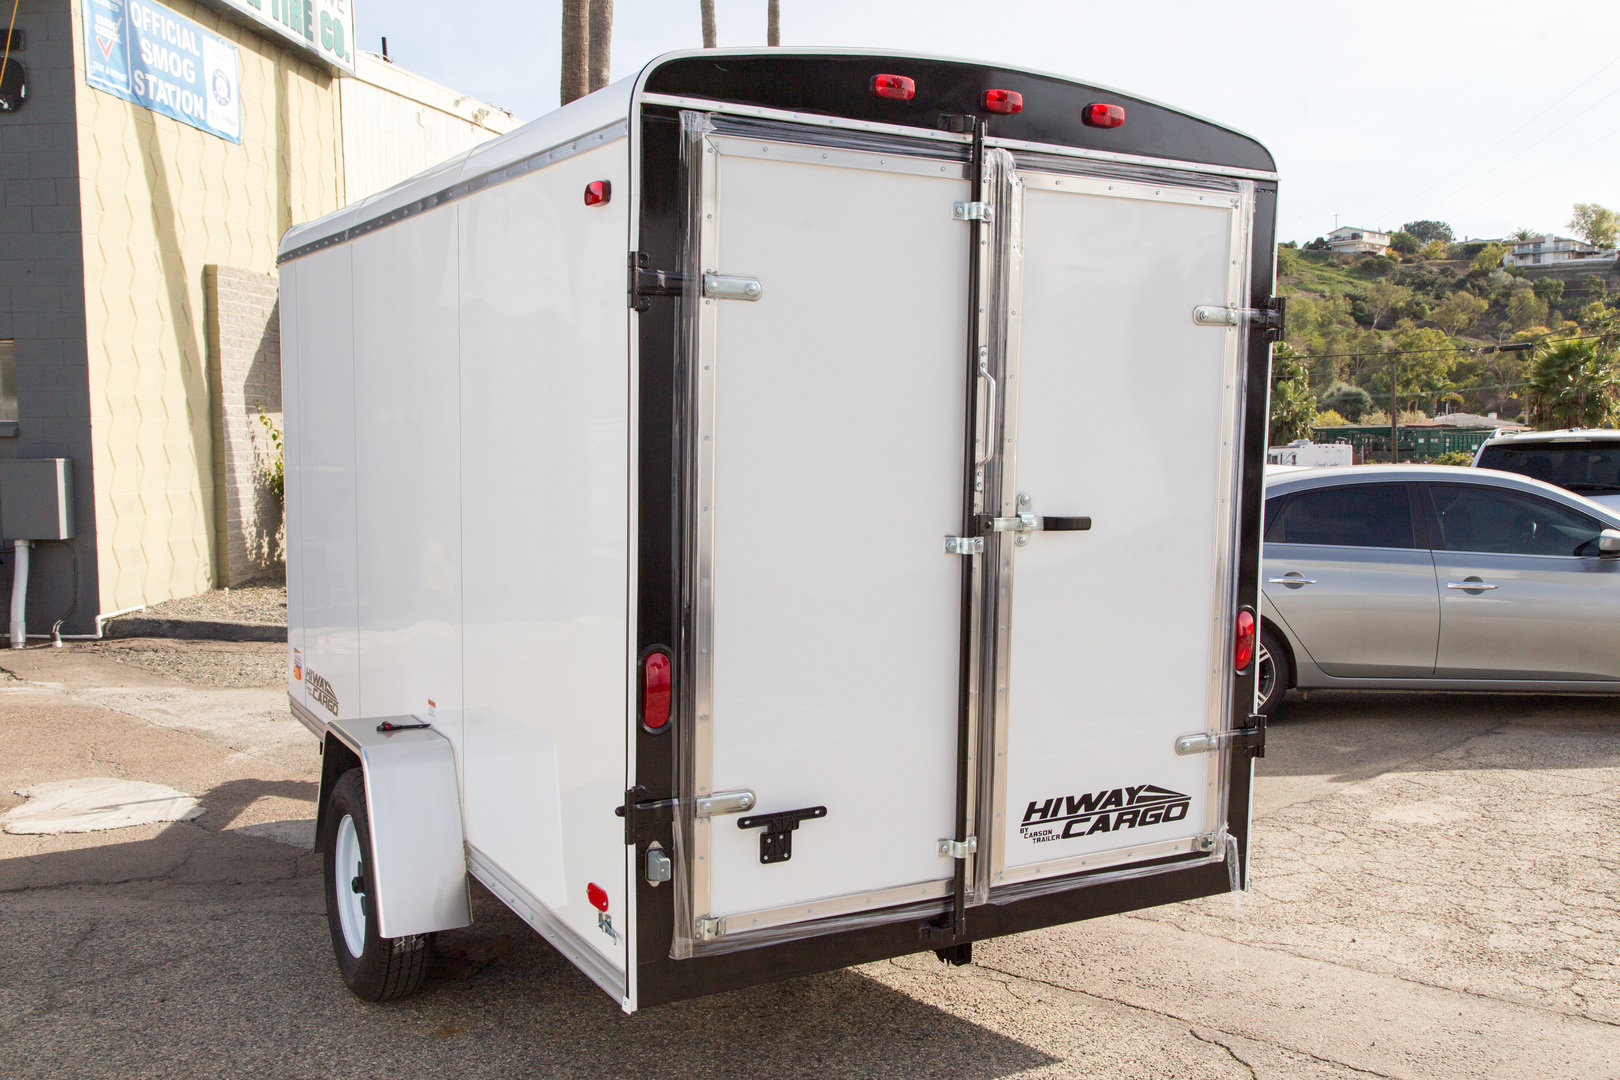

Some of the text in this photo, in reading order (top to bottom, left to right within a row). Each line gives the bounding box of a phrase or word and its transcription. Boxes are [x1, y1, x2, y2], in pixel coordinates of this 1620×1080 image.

[130, 1, 200, 57] OFFICIAL
[320, 9, 350, 64] CO.
[140, 37, 196, 84] SMOG
[134, 69, 205, 121] STATION
[305, 666, 329, 692] HIWAY
[312, 688, 339, 717] CARGO
[1022, 784, 1148, 823] HIWAY
[1061, 801, 1190, 840] CARGO
[1024, 829, 1053, 839] CARSON
[1032, 834, 1061, 844] TRAILER
